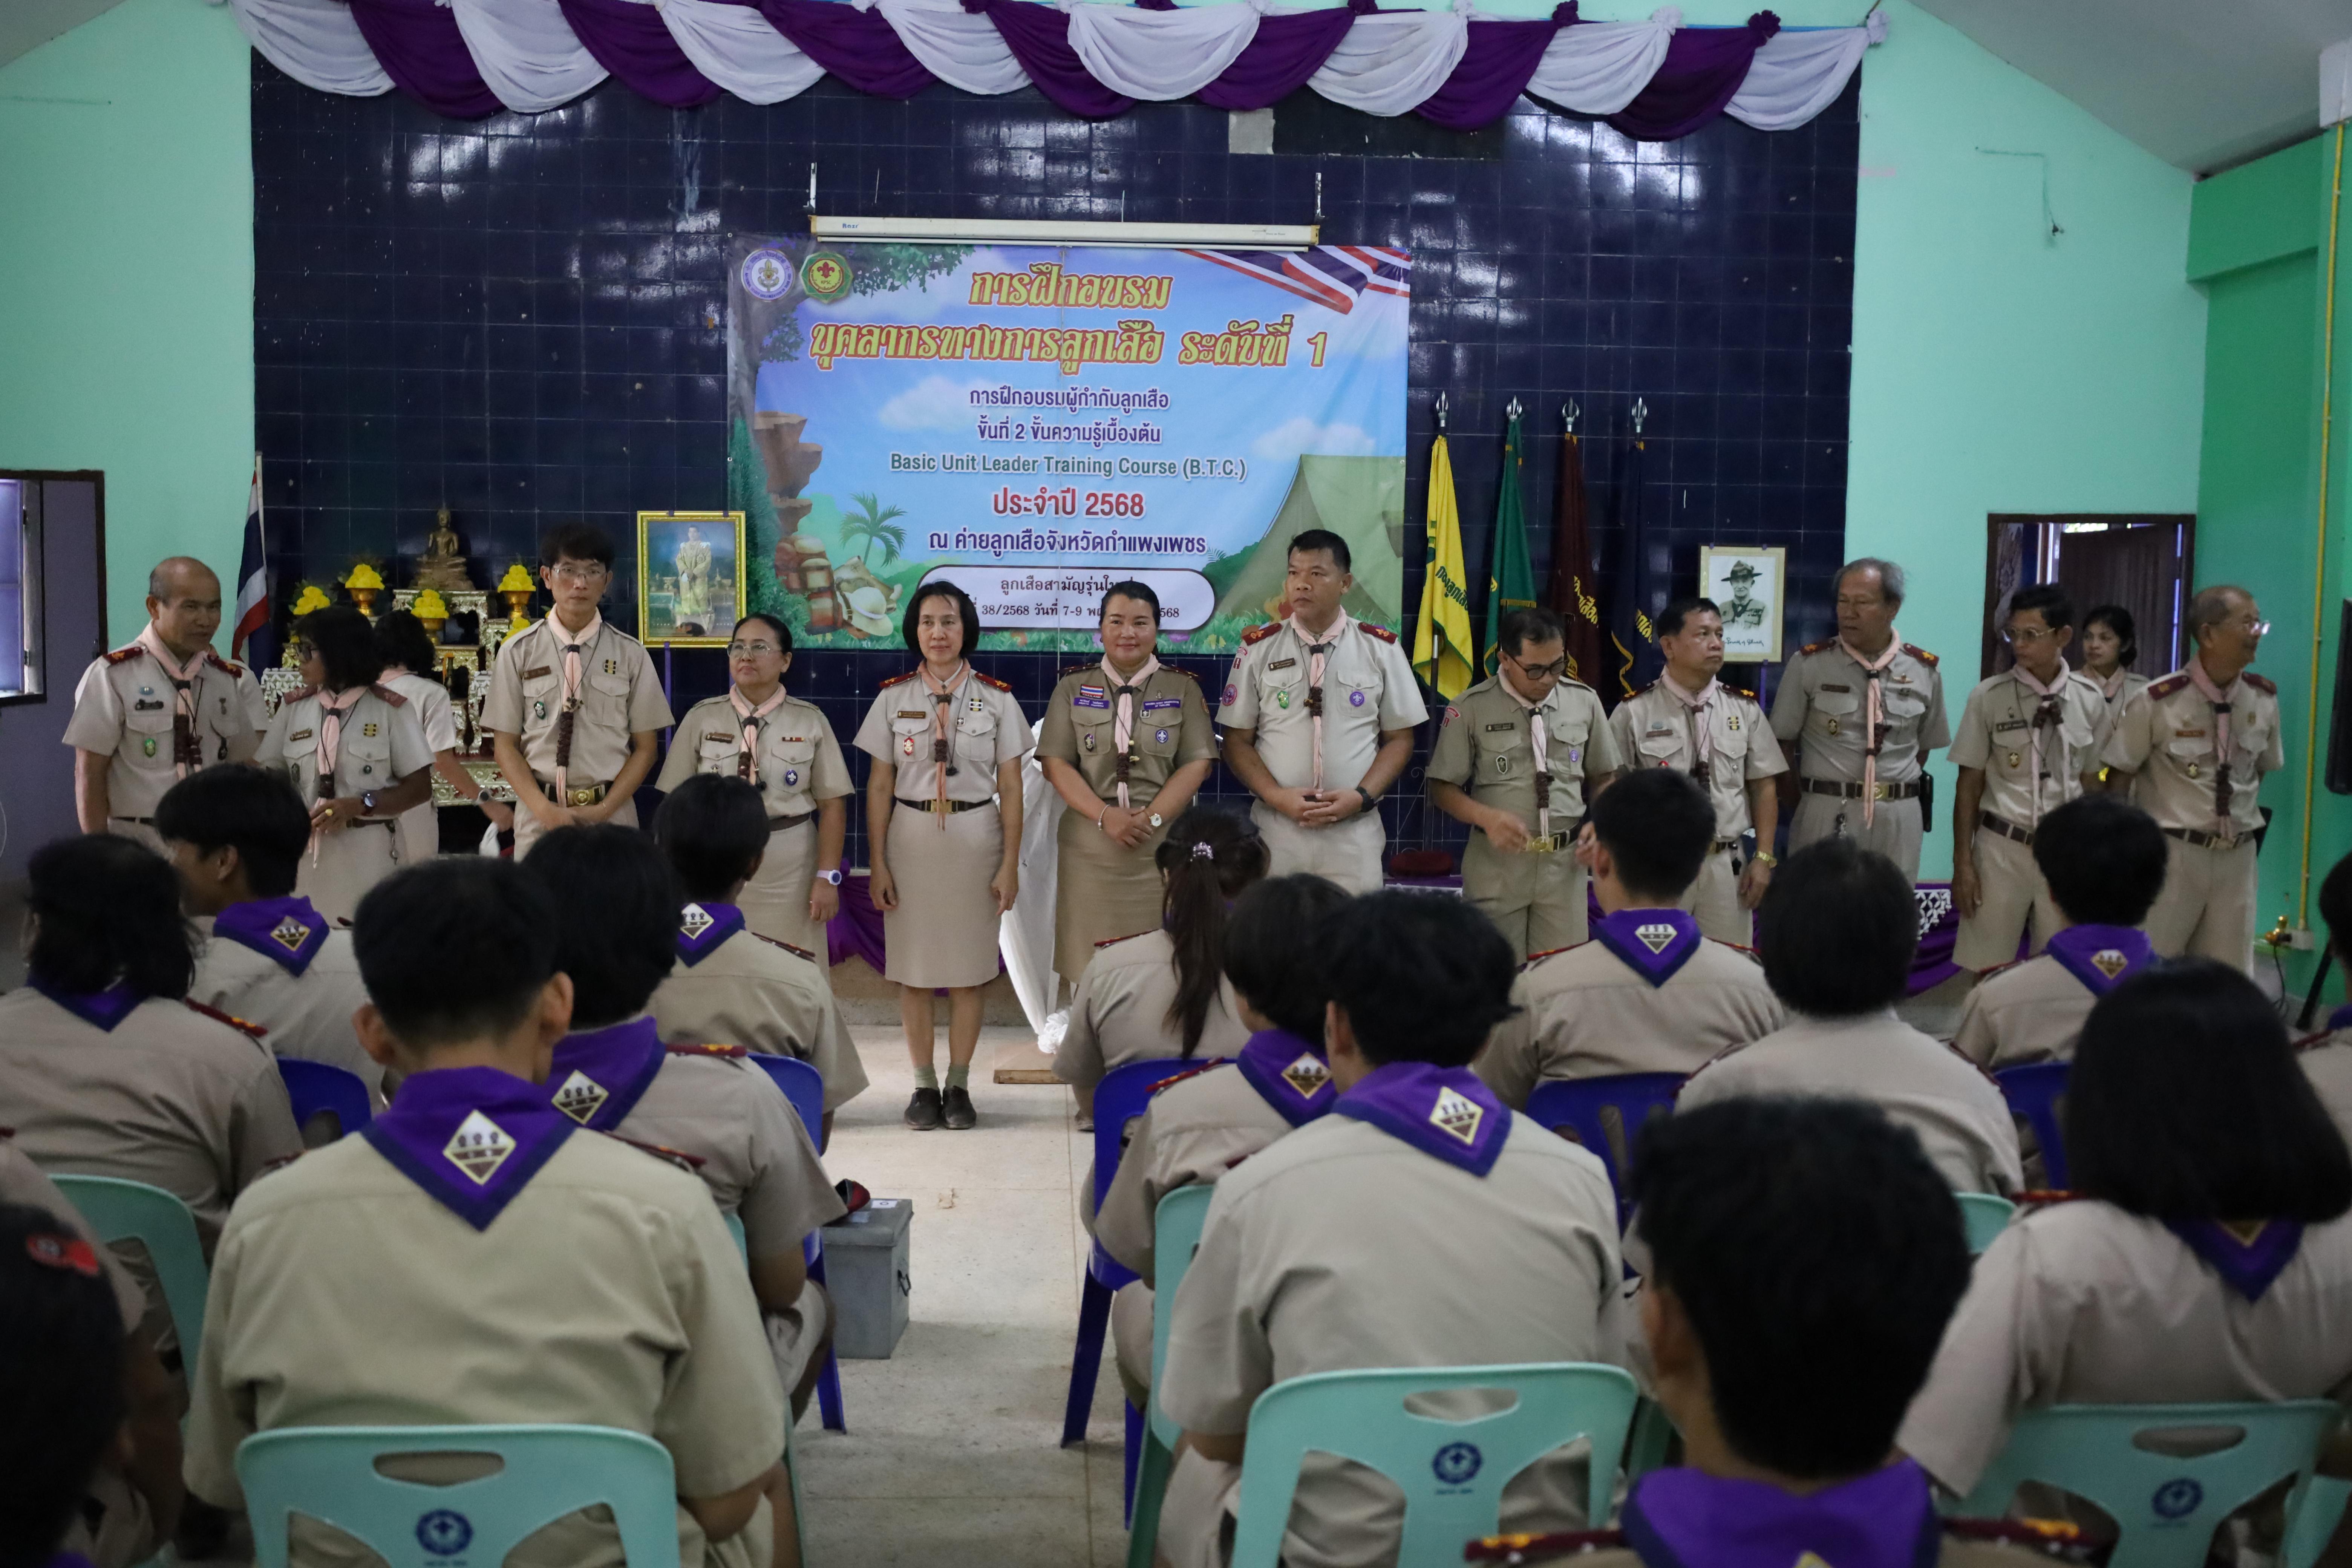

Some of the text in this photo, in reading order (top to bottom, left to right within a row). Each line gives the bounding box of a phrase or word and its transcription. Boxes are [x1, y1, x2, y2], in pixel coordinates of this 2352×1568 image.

[969, 263, 1172, 309] การฝึกอบรม
[810, 315, 1327, 375] บุคลากรทางการลูกเสือ ระดับที่ 1
[970, 386, 1169, 414] การฝึกอบรมผู้กำกับลูกเสือ
[978, 415, 1161, 448] ขั้นที่ 2 ขั้นความรู้เบื้องต้น
[891, 454, 1246, 480] Basic Unit Leader Training Course (B.T.C.)
[994, 487, 1144, 517] ประจำปี 2568
[929, 528, 1207, 557] ณ ค่ายลูกเสือจังหวัดกำแพงเพชร
[982, 605, 1031, 616] 38/2568
[1035, 599, 1058, 616] วันที่
[1063, 606, 1082, 616] 7-9
[1160, 608, 1179, 618] 568
